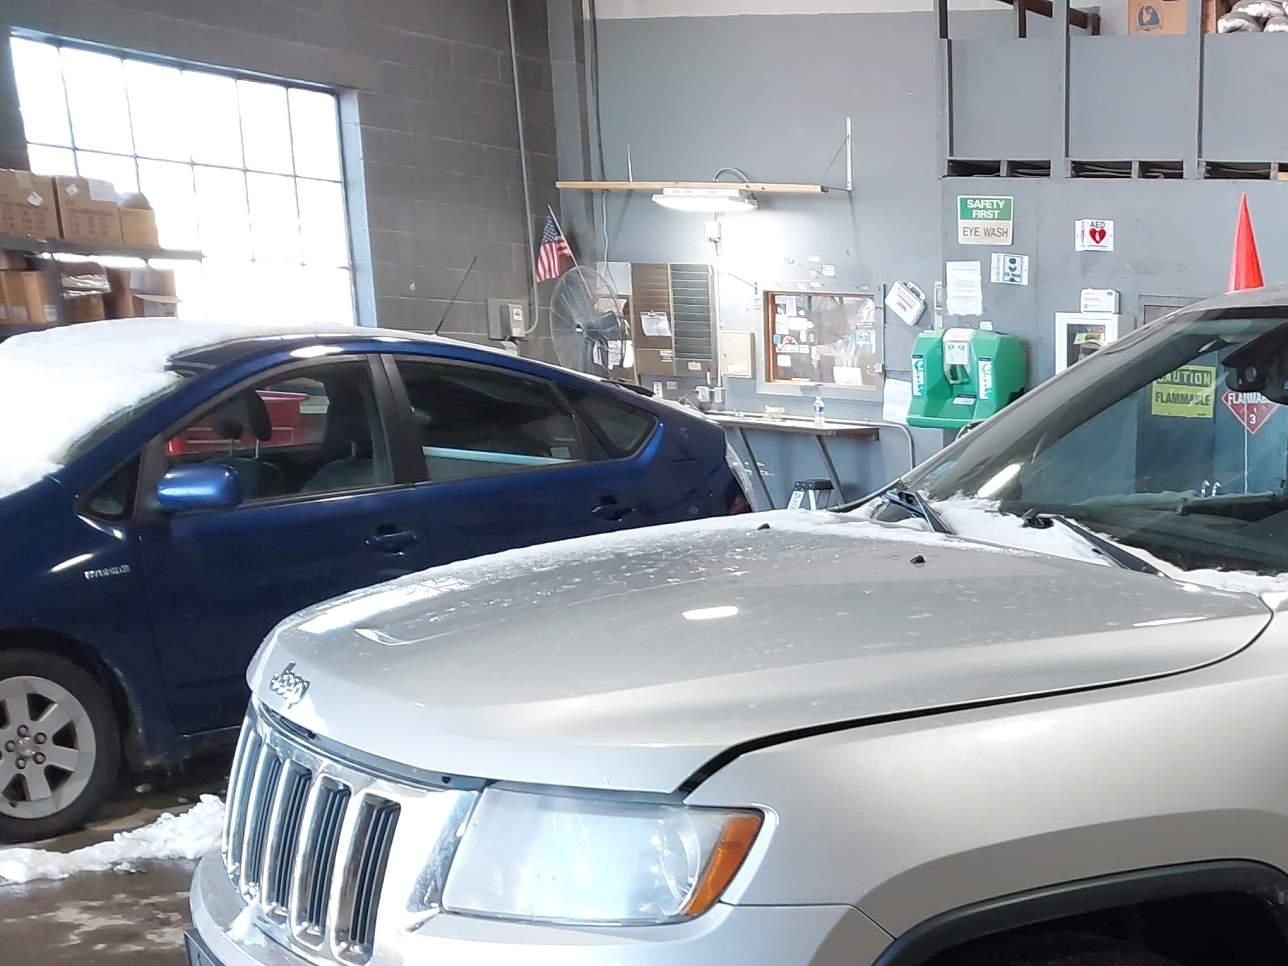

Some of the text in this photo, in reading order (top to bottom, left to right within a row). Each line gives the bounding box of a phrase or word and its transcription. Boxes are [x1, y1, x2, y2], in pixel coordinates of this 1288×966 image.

[966, 199, 1005, 209] SAFETY
[972, 209, 1001, 219] FIRST
[1089, 220, 1106, 229] AED
[962, 226, 1009, 238] EYE WASH
[1155, 391, 1212, 406] FLAMMABLE
[1248, 413, 1256, 425] 3
